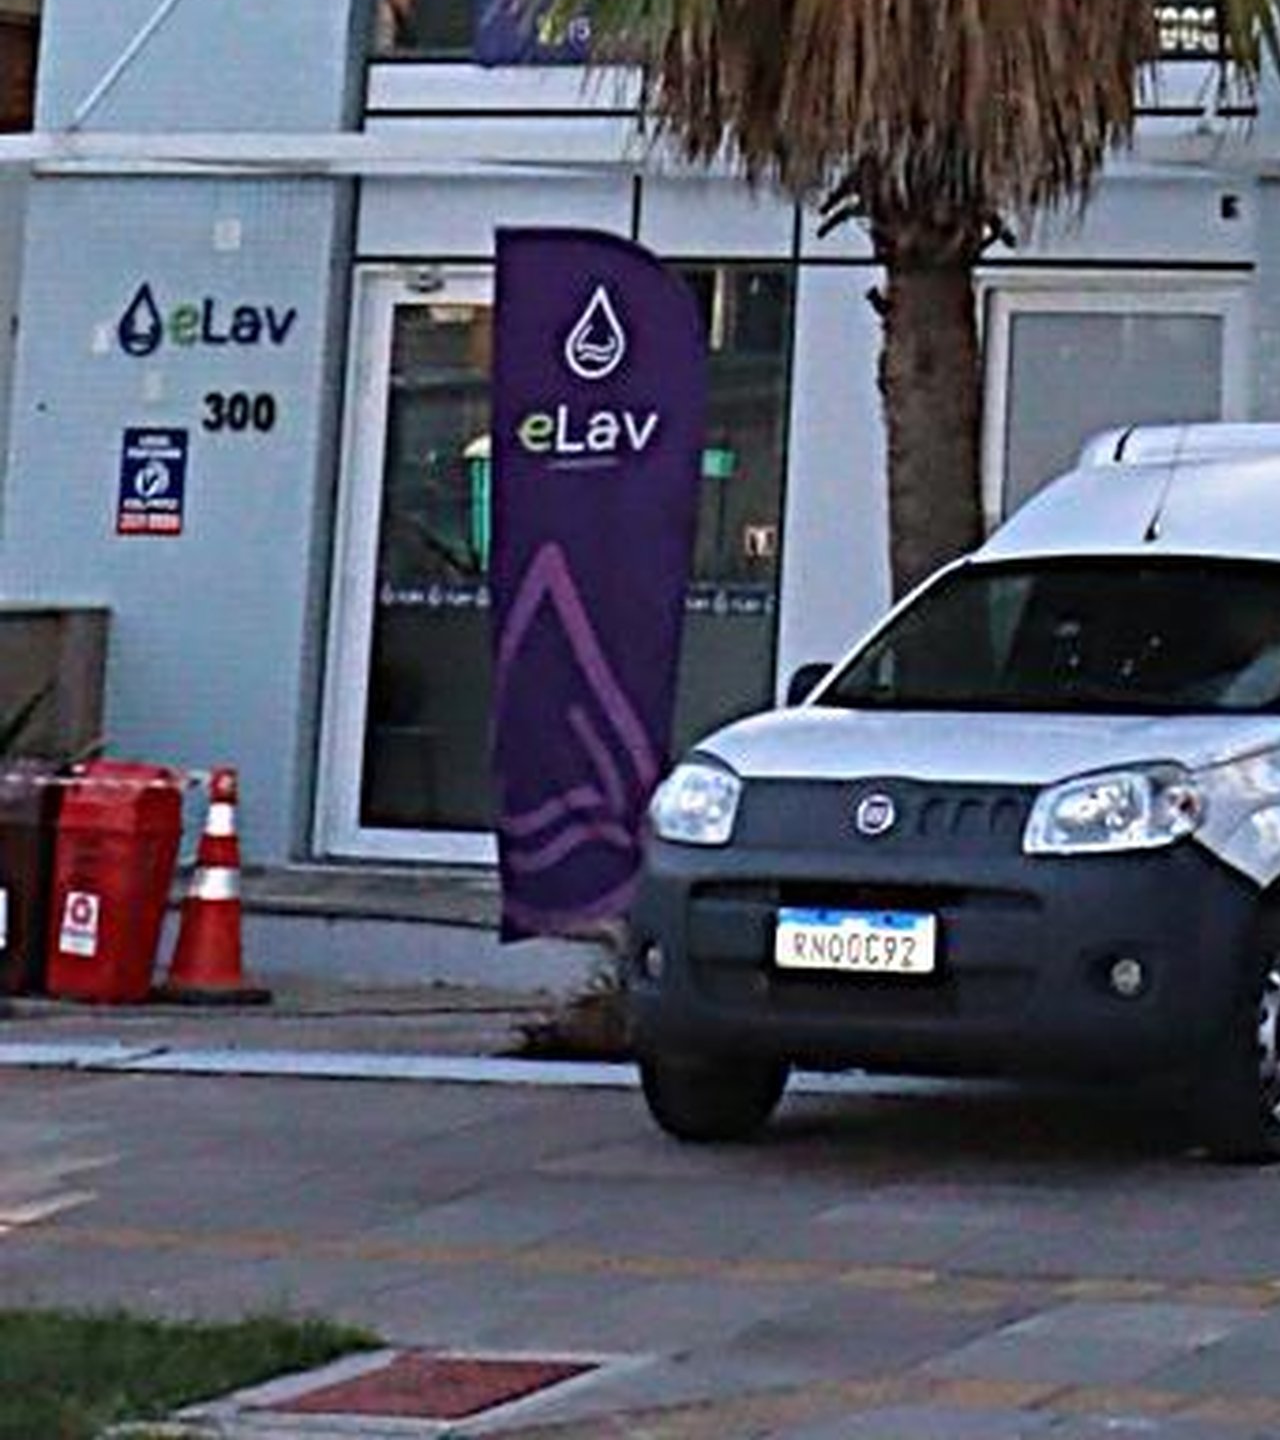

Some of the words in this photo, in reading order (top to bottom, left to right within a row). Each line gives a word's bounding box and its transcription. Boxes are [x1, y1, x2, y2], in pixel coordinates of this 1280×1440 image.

[169, 295, 297, 347] eLav
[203, 391, 276, 433] 300
[519, 404, 658, 452] eLav
